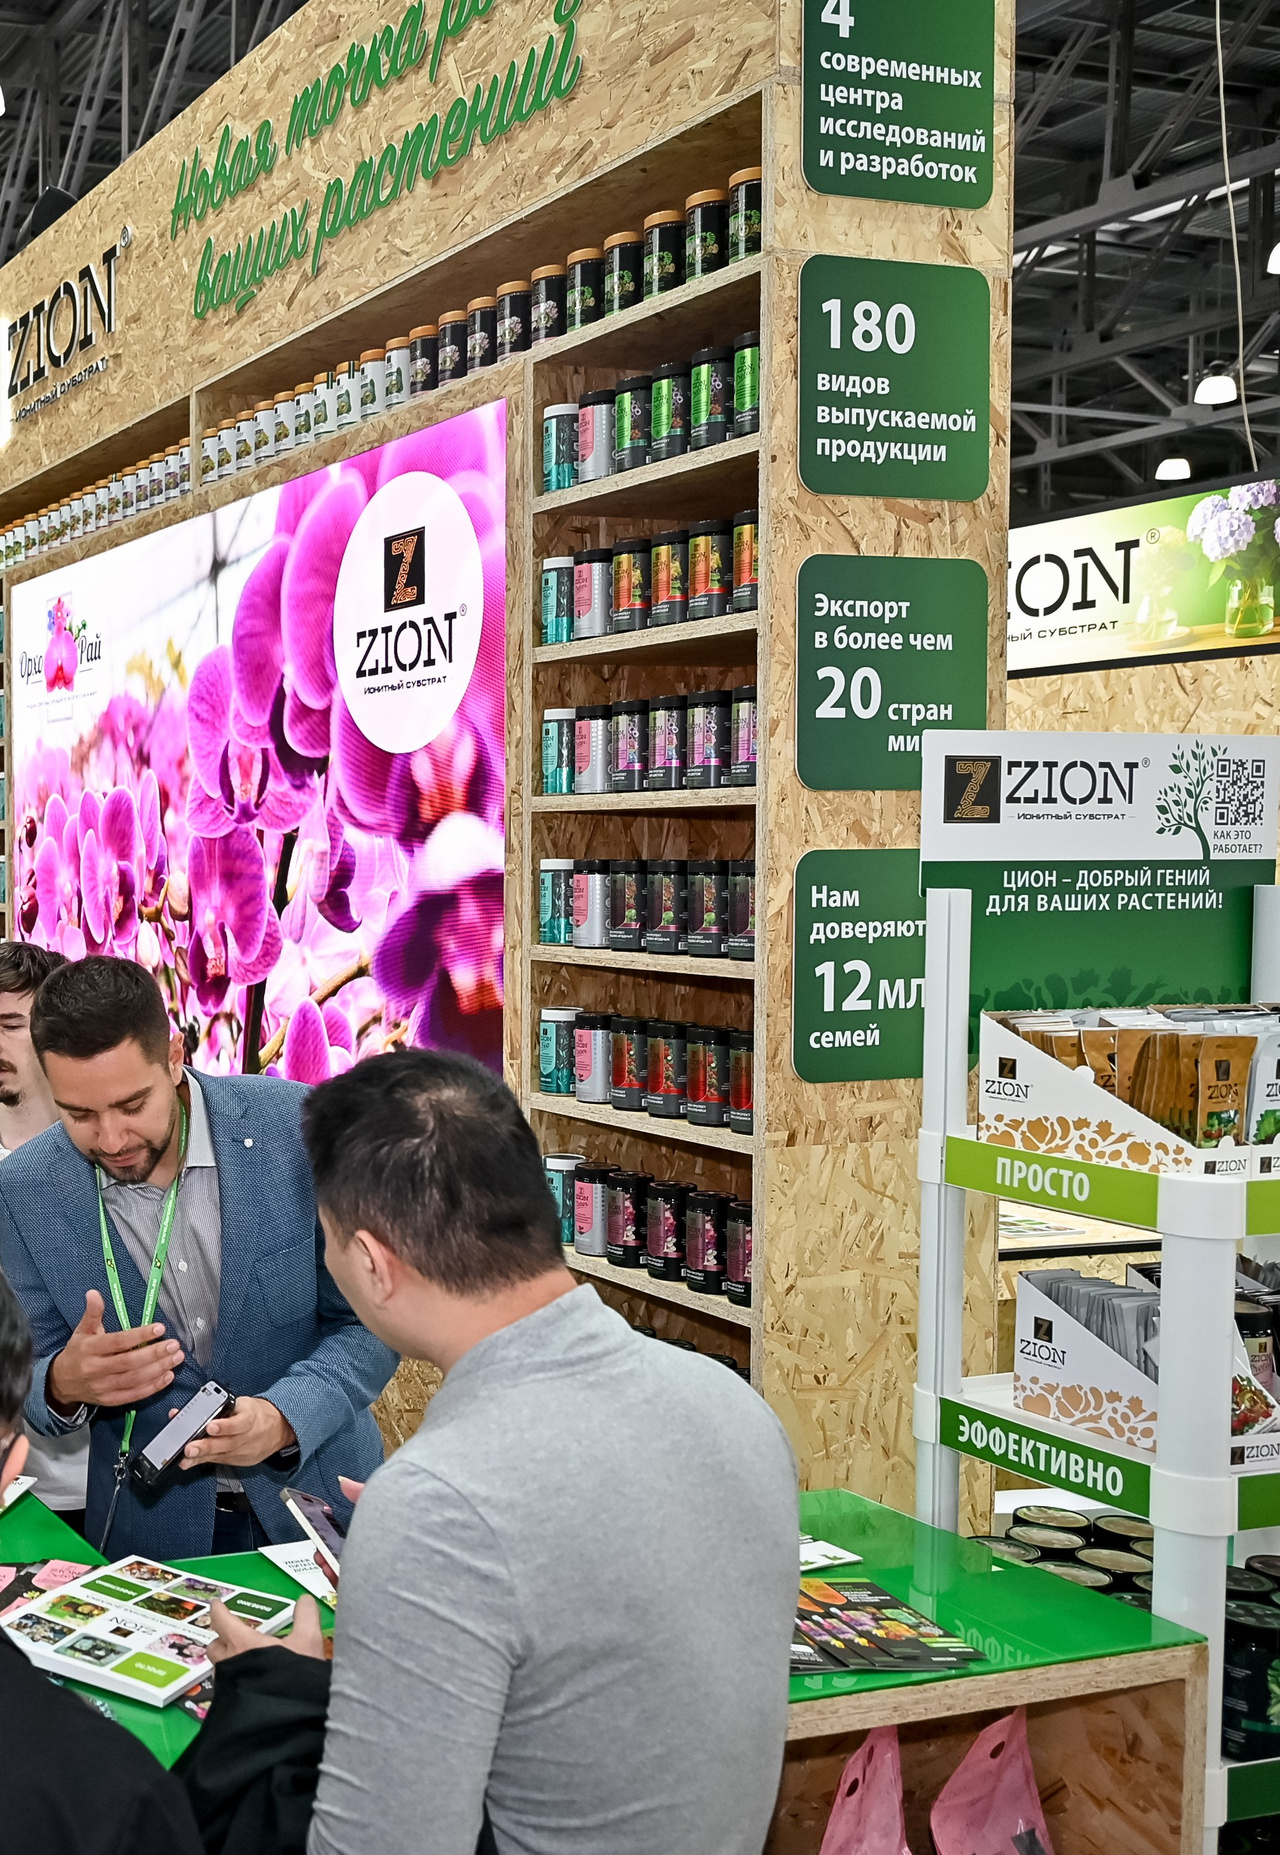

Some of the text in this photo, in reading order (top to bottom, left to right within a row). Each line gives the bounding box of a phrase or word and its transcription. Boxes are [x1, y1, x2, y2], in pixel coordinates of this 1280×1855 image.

[821, 0, 855, 38] 4
[820, 51, 982, 88] современных
[820, 83, 903, 114] центра
[171, 118, 277, 241] Новая
[285, 3, 428, 156] точка
[820, 116, 986, 153] исследований
[193, 198, 310, 320] ваших
[311, 0, 582, 276] растений
[820, 149, 977, 184] и разработок
[7, 243, 121, 400] ZION
[821, 298, 916, 355] 180
[817, 373, 890, 398] видов
[816, 405, 976, 432] выпускаемой
[816, 438, 947, 465] продукции
[1007, 538, 1140, 619] ON
[814, 593, 910, 624] Экспорт
[814, 625, 953, 651] в более чем
[1038, 620, 1119, 639] СУБСТРАТ
[356, 611, 457, 678] ZION
[363, 675, 447, 695] ИОНИТНЫЙ СУБСТРАТ
[815, 666, 953, 726] 20 стран
[888, 735, 922, 752] ми
[1005, 760, 1139, 805] ZION
[1017, 811, 1127, 821] ИОНИТНЫЙ СУБСТРАТ
[1213, 830, 1251, 840] КАК ЭТО
[1213, 843, 1263, 854] РАБОТАЕТ?
[1003, 870, 1057, 889] ЦИОН
[1076, 866, 1152, 890] ДОБРЫЙ
[1156, 866, 1210, 887] ГЕНИЙ
[811, 885, 860, 908] Нам
[985, 889, 1224, 916] ДЛЯ ВАШИХ РАСТЕНИЙ!
[809, 920, 926, 945] доверяют
[814, 959, 926, 1012] 12 мл
[809, 1023, 880, 1049] семей
[985, 1079, 1030, 1099] ZION
[1208, 1083, 1239, 1099] ZION
[1217, 1159, 1247, 1172] ZION
[996, 1157, 1090, 1202] ПРОСТО
[1019, 1338, 1067, 1366] ZION
[958, 1414, 1124, 1497] ЭФФЕКТИВНО
[1246, 1443, 1280, 1458] ZION
[109, 1616, 157, 1636] ZION
